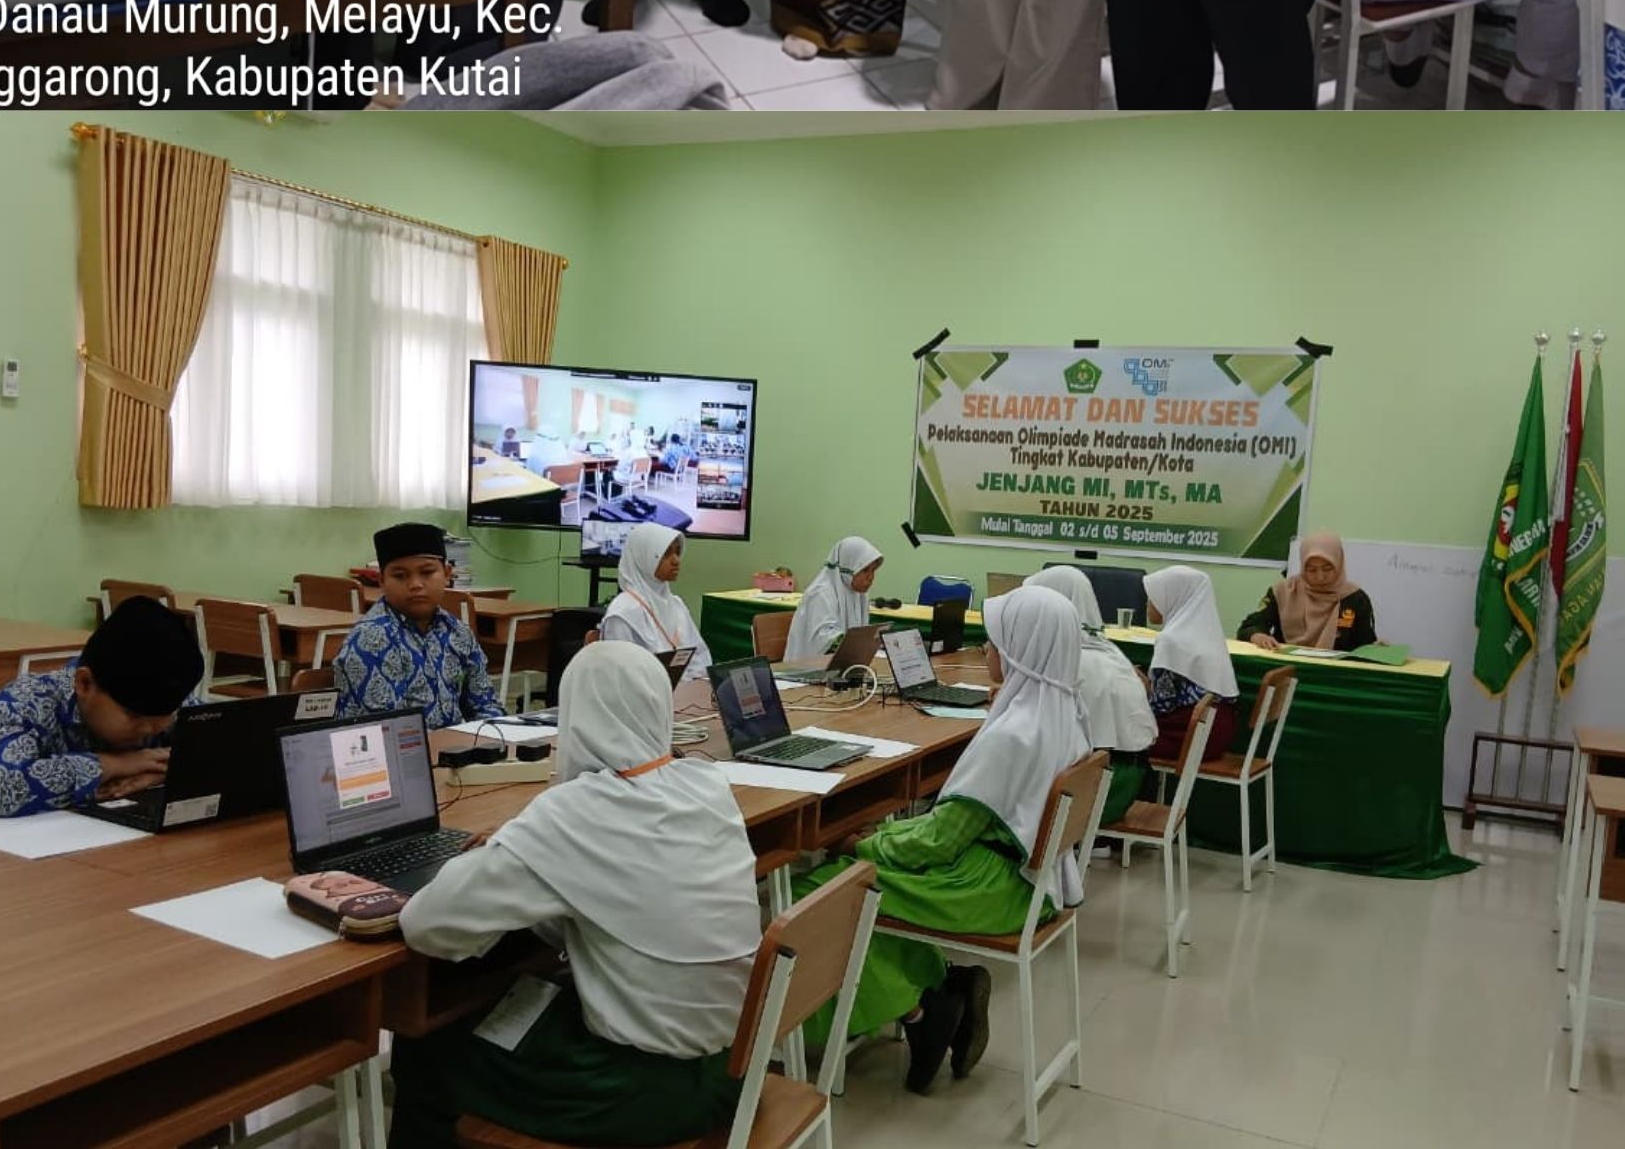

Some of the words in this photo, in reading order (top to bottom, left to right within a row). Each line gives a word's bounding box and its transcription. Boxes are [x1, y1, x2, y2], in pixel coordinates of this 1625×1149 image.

[962, 394, 1079, 422] SELAMAT
[1086, 397, 1146, 424] DAN
[1153, 398, 1261, 428] SUKSES
[928, 423, 1014, 444] Pelaksanaan
[1018, 425, 1090, 451] Olimpiade
[1093, 429, 1167, 451] Madrasah
[1170, 431, 1247, 453] Indonesia
[1250, 435, 1297, 460] (OMI)
[1010, 445, 1064, 471] Tingkat
[1067, 449, 1195, 477] Kabupaten/Kota
[975, 472, 1076, 497] JENJANG
[1082, 477, 1116, 501] MI,
[1124, 479, 1177, 504] MTs,
[1185, 482, 1223, 504] MA
[1040, 500, 1100, 518] TAHUN
[1106, 504, 1153, 521] 2025
[981, 516, 1011, 533] Mulai
[1012, 519, 1054, 538] Tanggal
[1060, 524, 1076, 537] 02
[1078, 523, 1099, 539] s/d
[1103, 525, 1119, 539] 05
[1123, 527, 1185, 545] September
[1187, 530, 1219, 547] 2025
